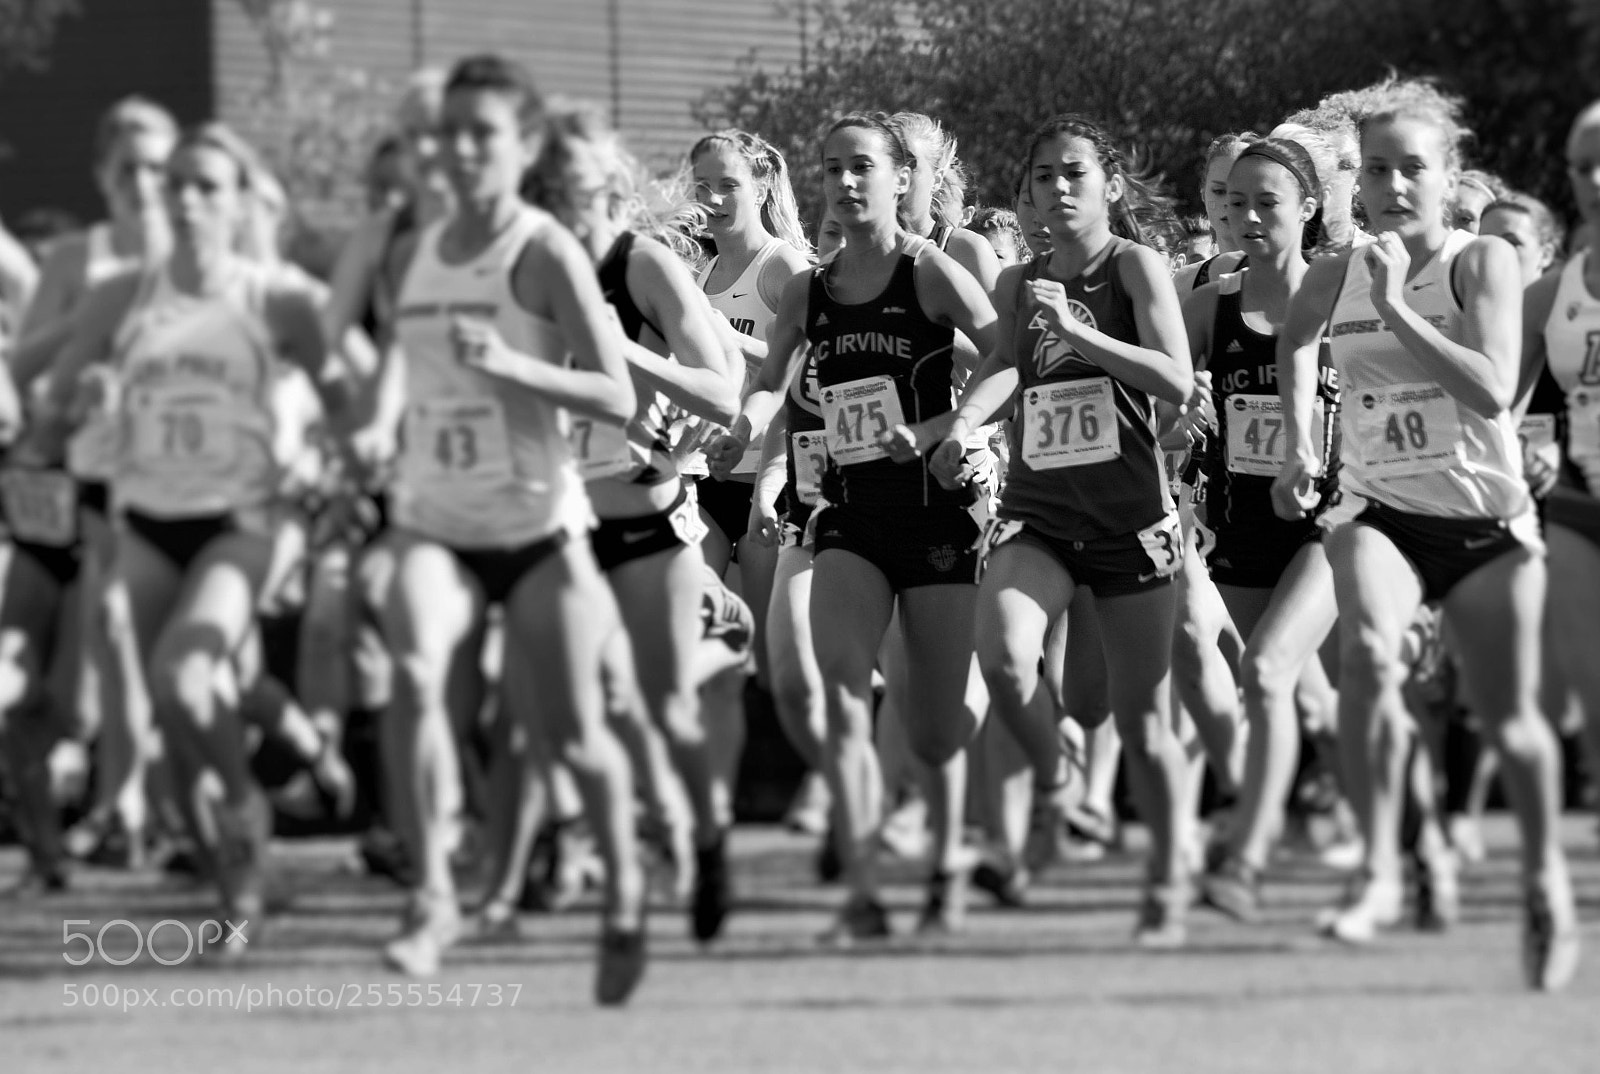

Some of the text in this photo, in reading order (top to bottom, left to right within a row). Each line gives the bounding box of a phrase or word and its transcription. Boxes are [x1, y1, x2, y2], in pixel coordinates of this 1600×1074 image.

[836, 332, 912, 359] IRVINE
[1222, 369, 1249, 393] UC
[837, 400, 888, 444] 475
[1037, 404, 1099, 449] 376
[1386, 411, 1427, 451] 48
